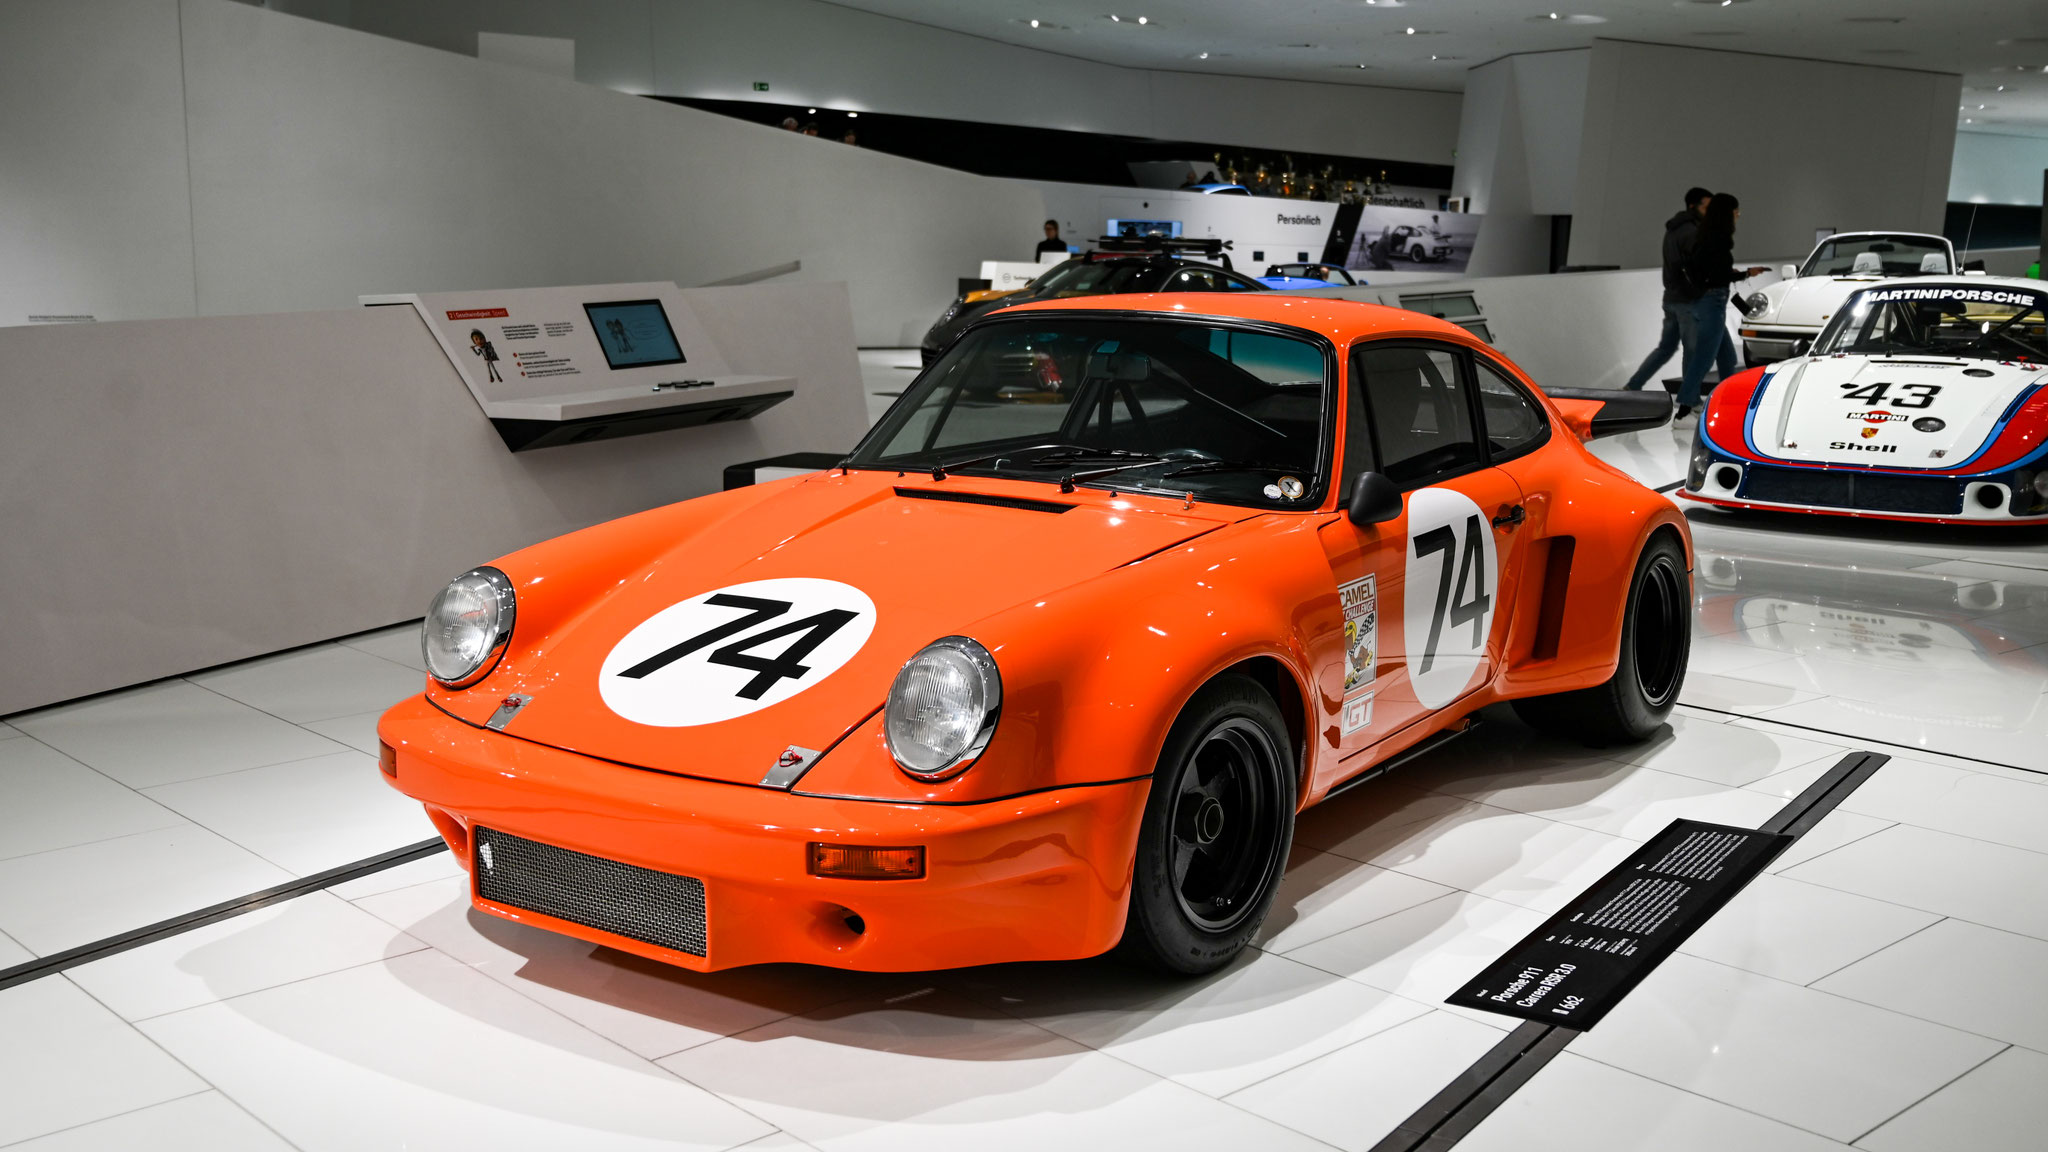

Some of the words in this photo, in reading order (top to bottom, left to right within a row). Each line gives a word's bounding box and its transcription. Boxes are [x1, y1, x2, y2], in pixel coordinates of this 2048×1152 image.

[1277, 213, 1321, 225] Persönlich
[1842, 382, 1944, 409] 43
[1848, 413, 1907, 421] MARTINI
[1829, 441, 1897, 453] Shell
[1340, 582, 1374, 608] CAMEL
[1412, 513, 1490, 676] 74
[1345, 600, 1374, 621] CHALLENGE
[616, 593, 860, 701] 74
[1349, 698, 1372, 727] GT
[1491, 978, 1530, 1003] Porsche
[1518, 966, 1544, 980] 911
[1515, 985, 1552, 1007] Carrera
[1539, 972, 1567, 987] RSR
[1554, 963, 1577, 975] 3.0
[1558, 995, 1584, 1010] 662
